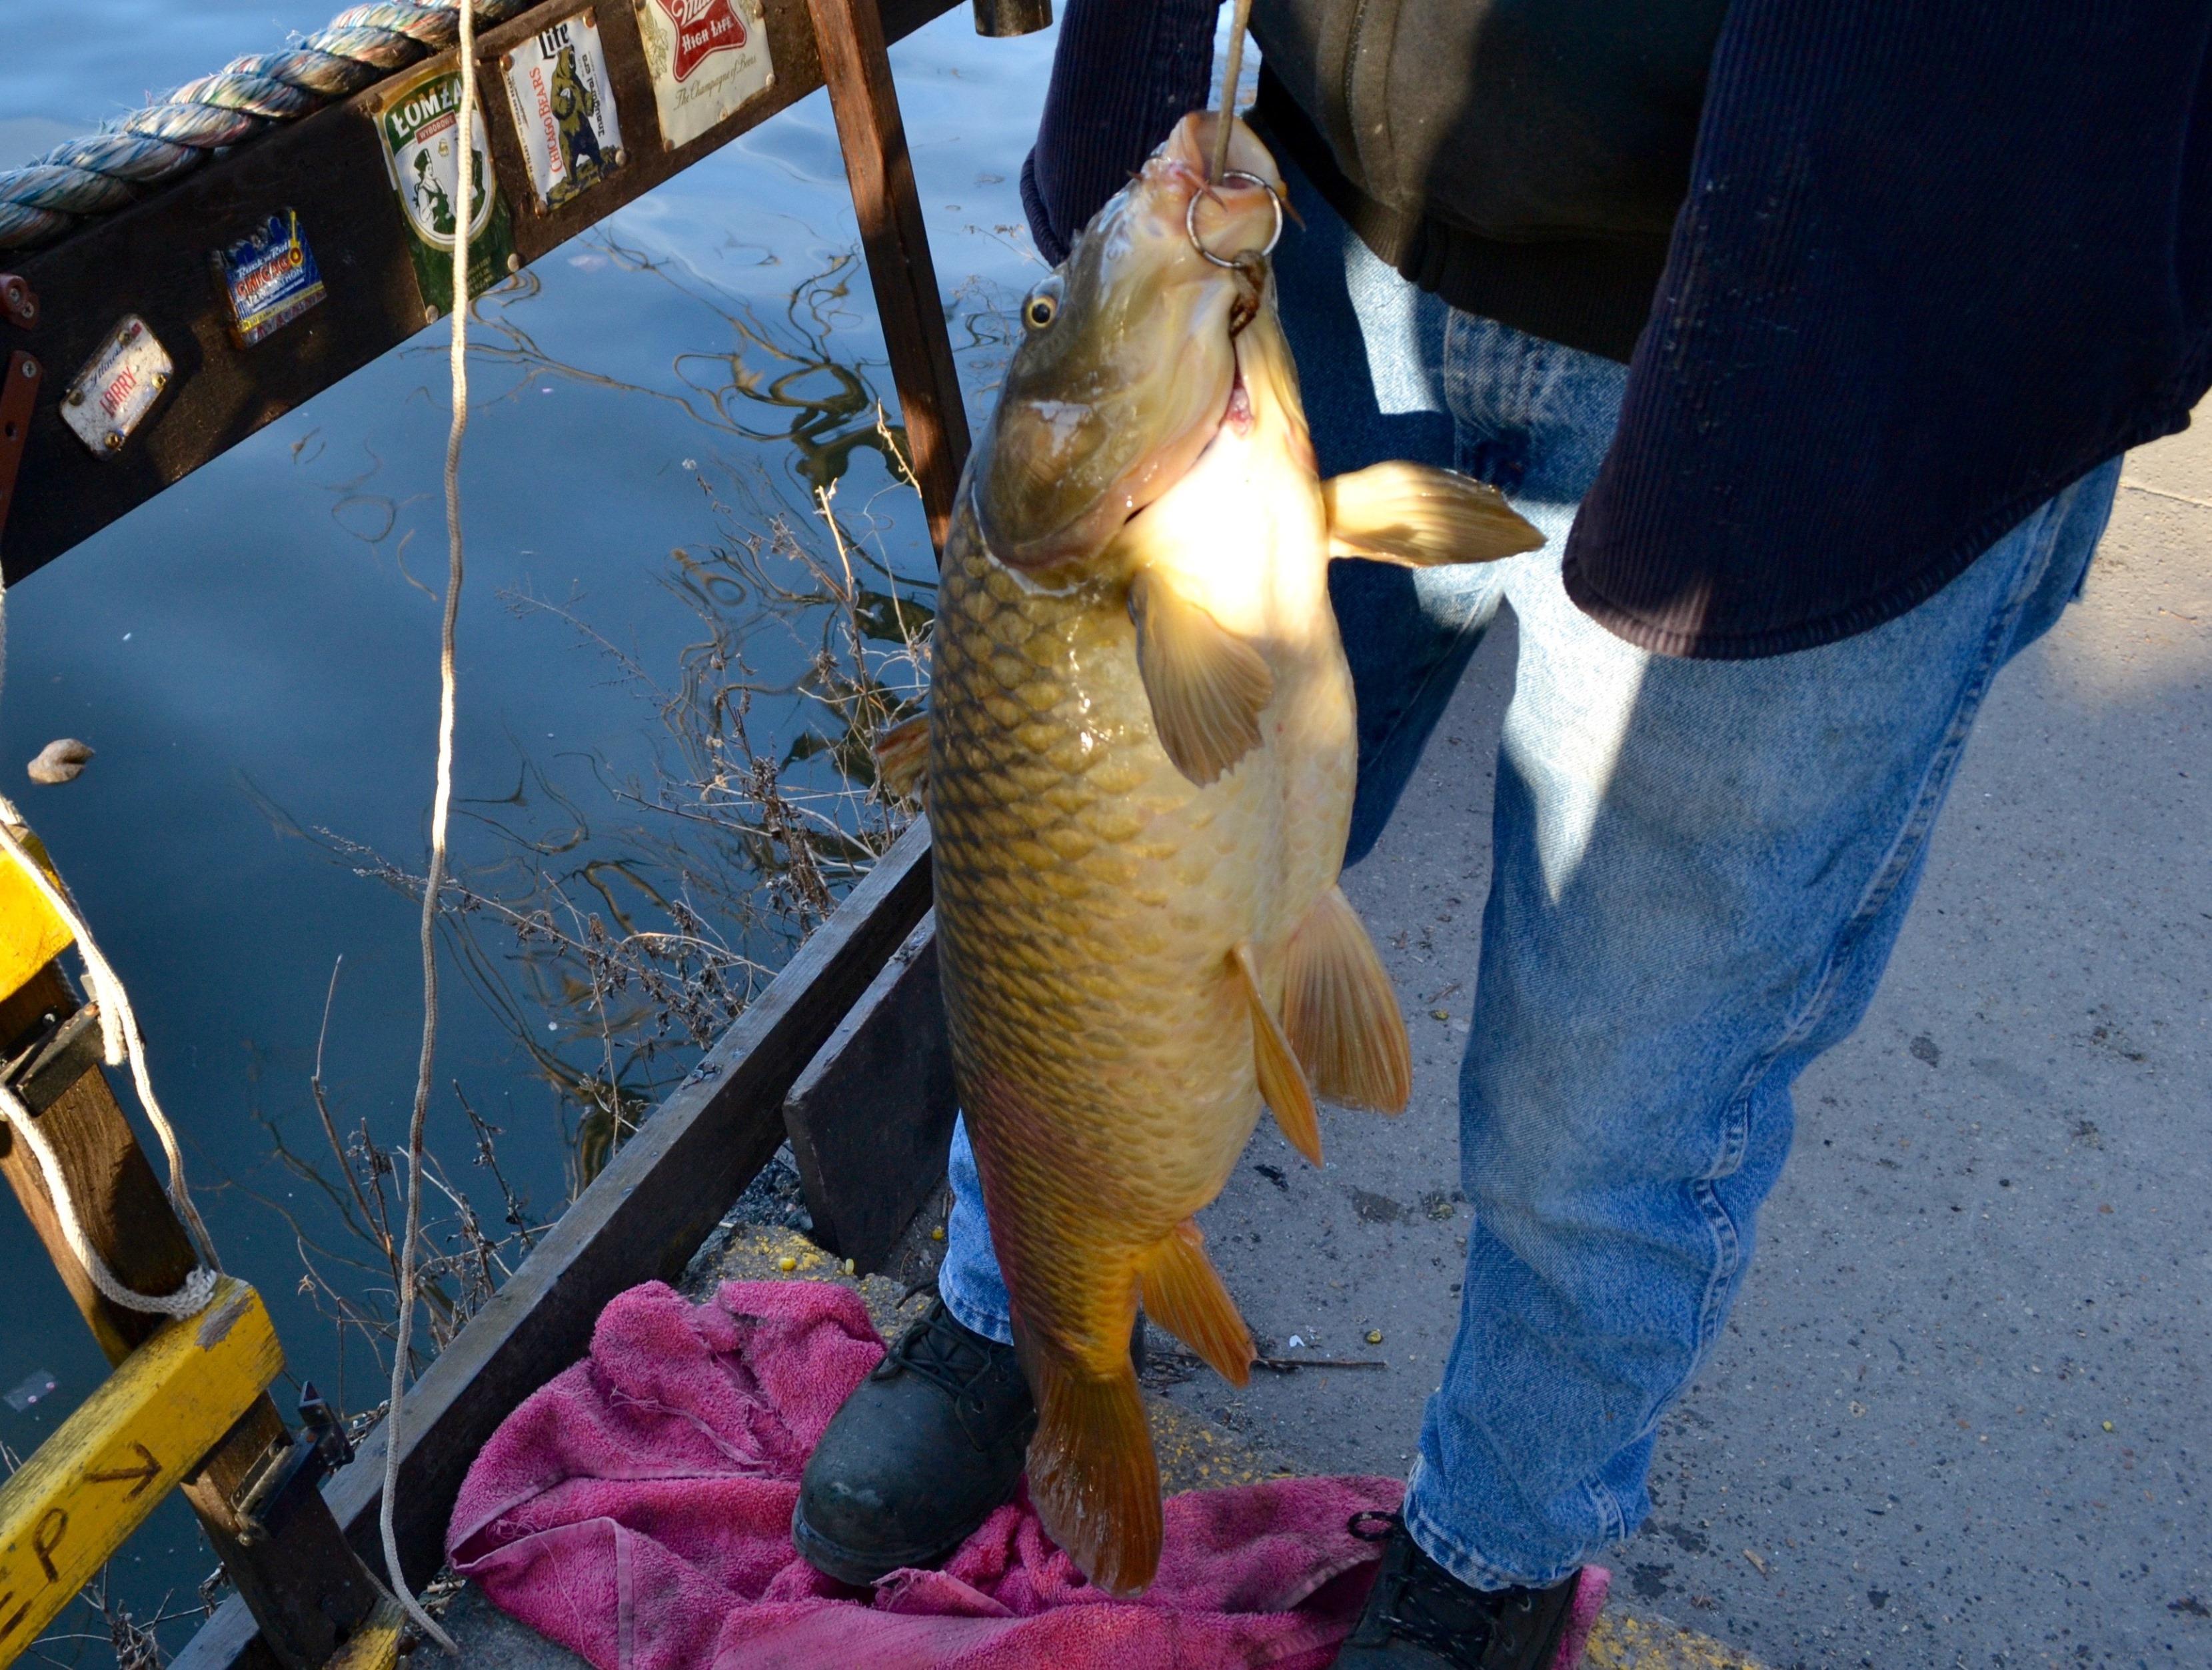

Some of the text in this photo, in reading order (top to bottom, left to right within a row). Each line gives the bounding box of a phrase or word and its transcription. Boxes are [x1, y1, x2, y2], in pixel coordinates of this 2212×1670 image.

[539, 23, 569, 59] Lite
[582, 53, 591, 75] era
[682, 29, 709, 55] HIGH
[586, 77, 605, 137] Inaugural
[673, 87, 690, 111] The
[690, 71, 730, 100] Champagne
[730, 59, 738, 83] of
[529, 67, 563, 173] CHICAGO BEARS
[236, 247, 303, 297] CHICAGO
[99, 365, 137, 419] LARRY
